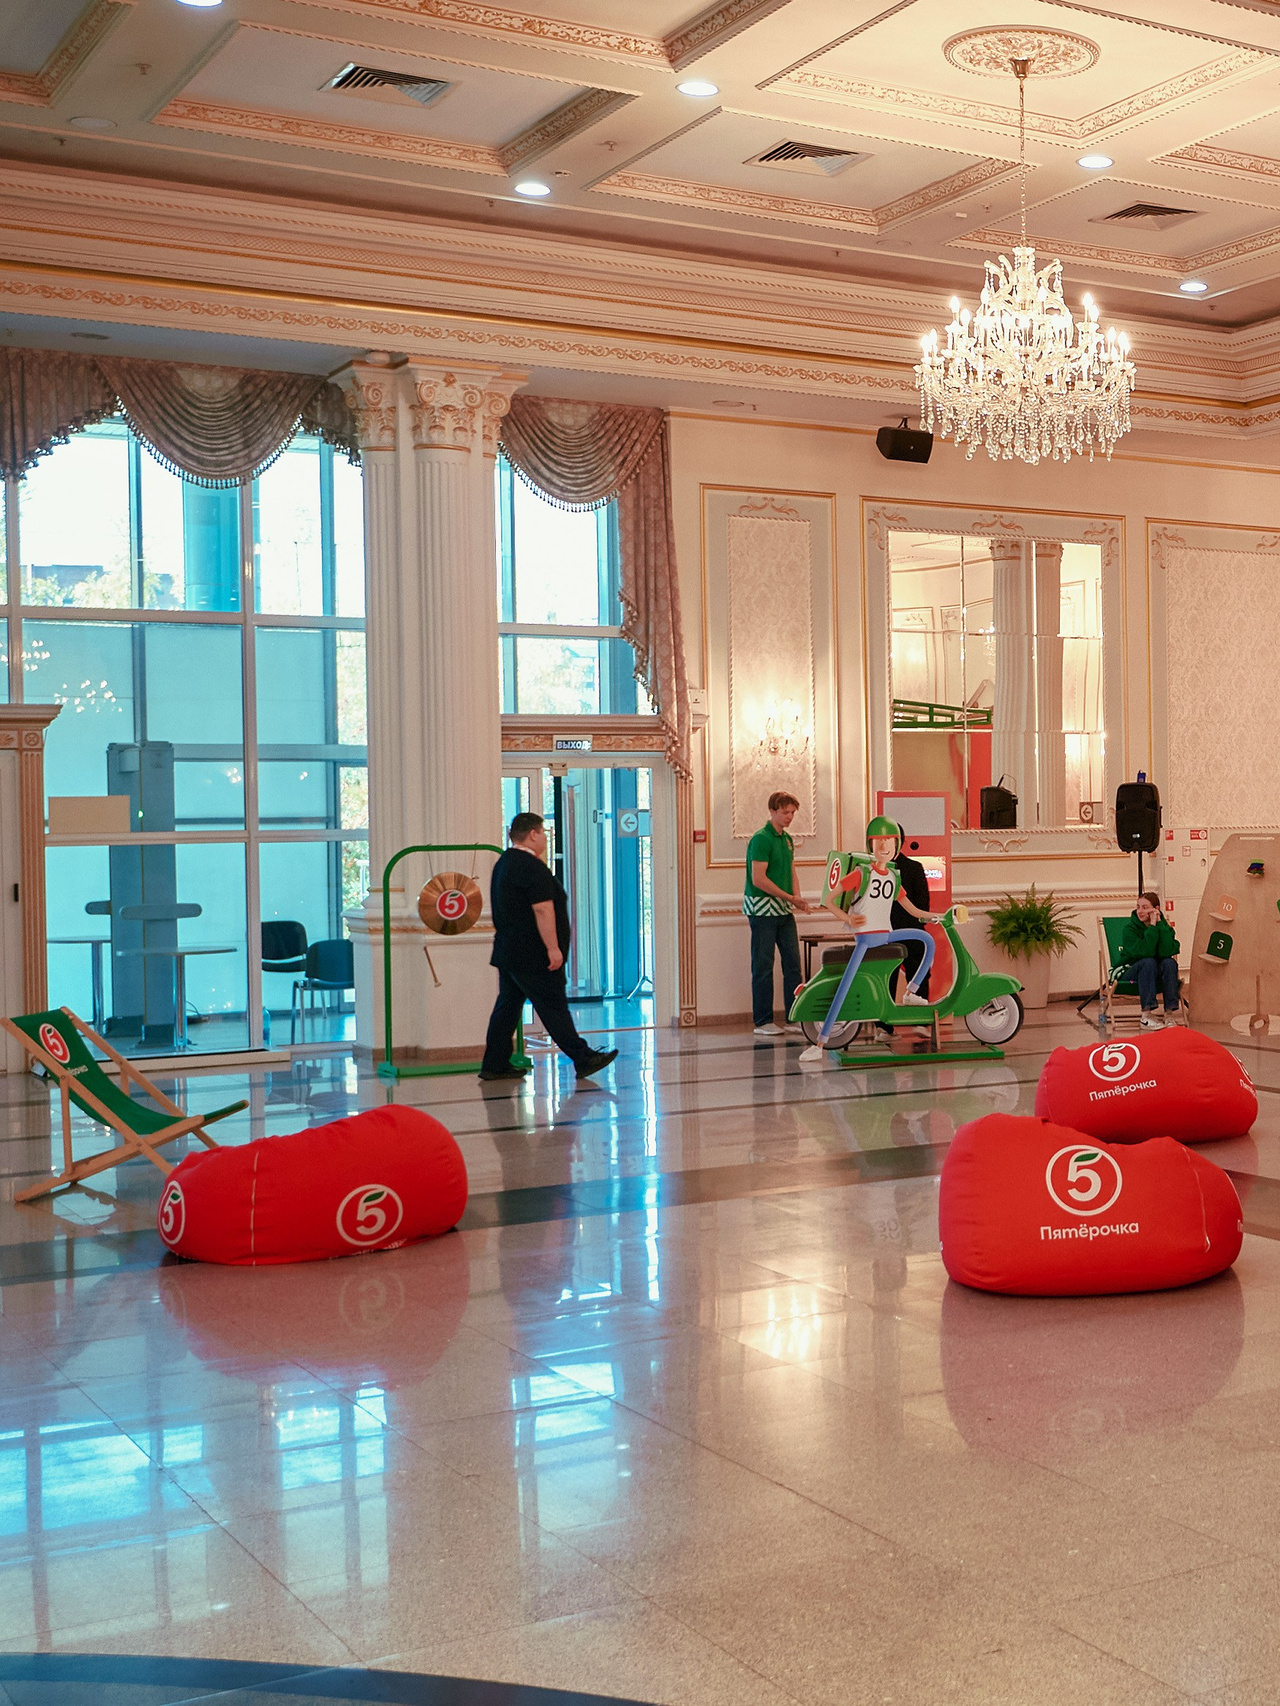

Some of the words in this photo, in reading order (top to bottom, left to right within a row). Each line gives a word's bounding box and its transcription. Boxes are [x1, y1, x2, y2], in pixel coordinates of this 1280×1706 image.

[557, 740, 589, 751] ВЫХОД
[869, 879, 894, 900] 30
[1222, 902, 1233, 912] 10
[1216, 939, 1225, 950] 5
[1089, 1079, 1157, 1101] Пятёрочка
[1040, 1221, 1140, 1241] Пятёрочка
